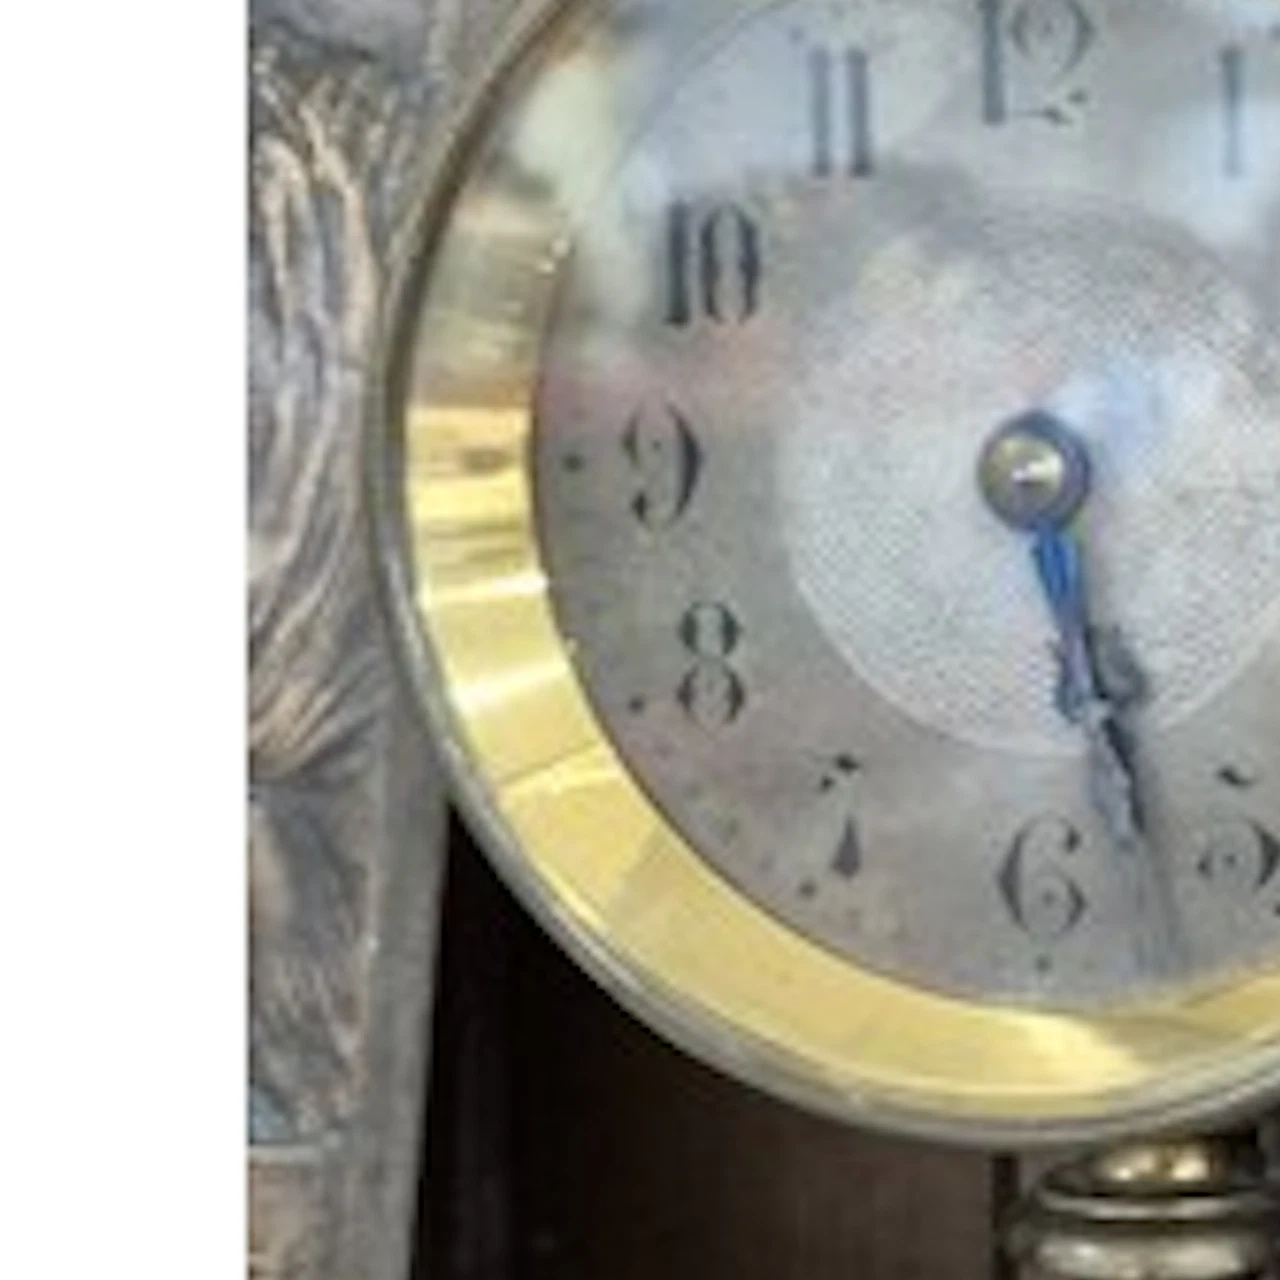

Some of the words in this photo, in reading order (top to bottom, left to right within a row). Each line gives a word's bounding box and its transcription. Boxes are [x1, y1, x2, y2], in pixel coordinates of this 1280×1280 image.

[806, 45, 874, 178] 11
[1220, 43, 1248, 178] 1
[664, 200, 763, 327] 10
[620, 403, 704, 526] 9
[676, 598, 747, 725] 8
[806, 752, 866, 880] 7
[1000, 816, 1089, 938] 6
